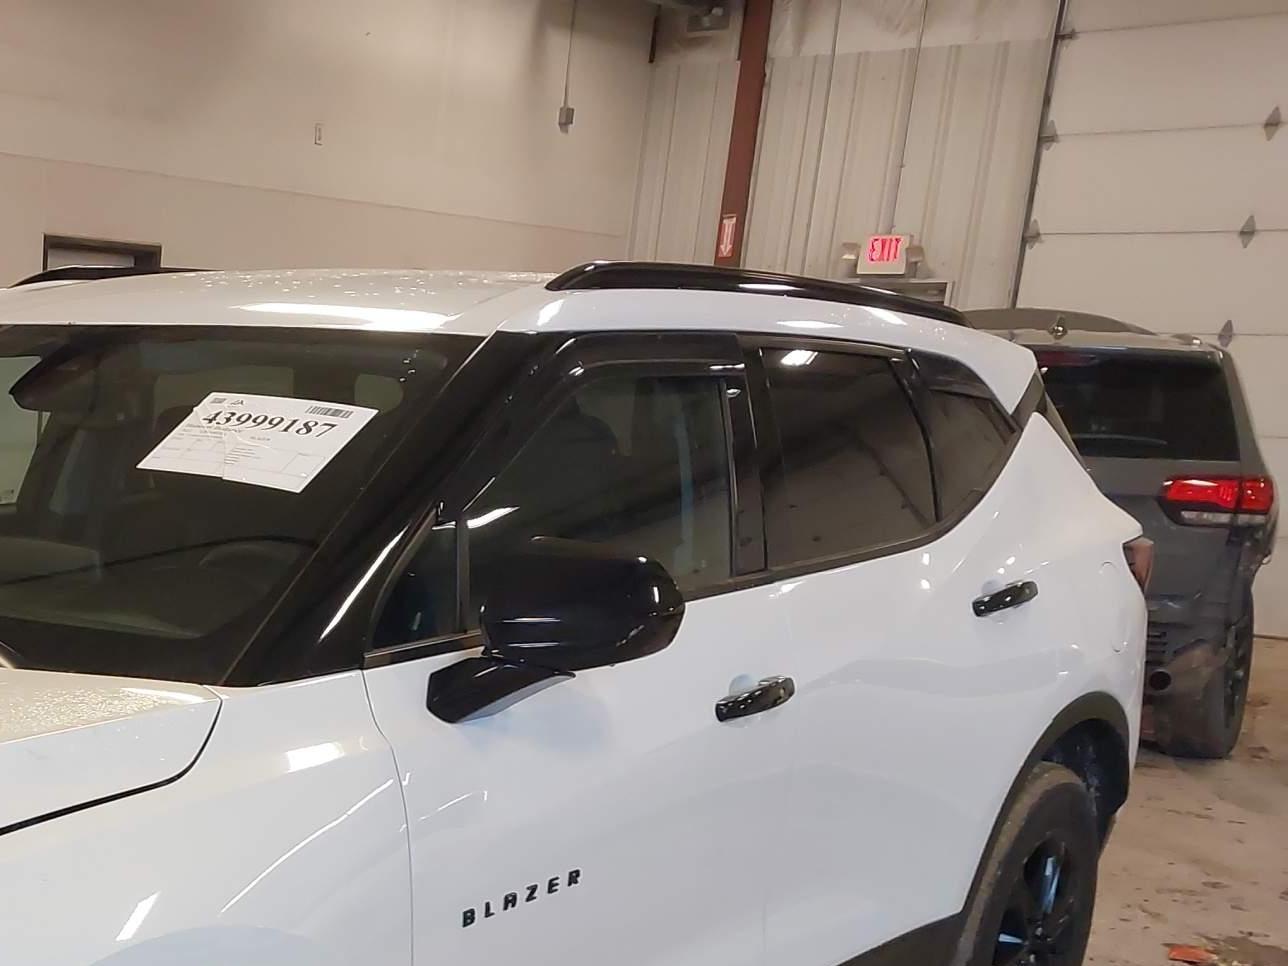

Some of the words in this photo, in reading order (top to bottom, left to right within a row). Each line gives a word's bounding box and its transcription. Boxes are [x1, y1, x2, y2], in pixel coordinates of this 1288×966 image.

[867, 237, 904, 263] EXIT
[202, 410, 339, 438] 43999187
[461, 868, 581, 928] BLAZER
